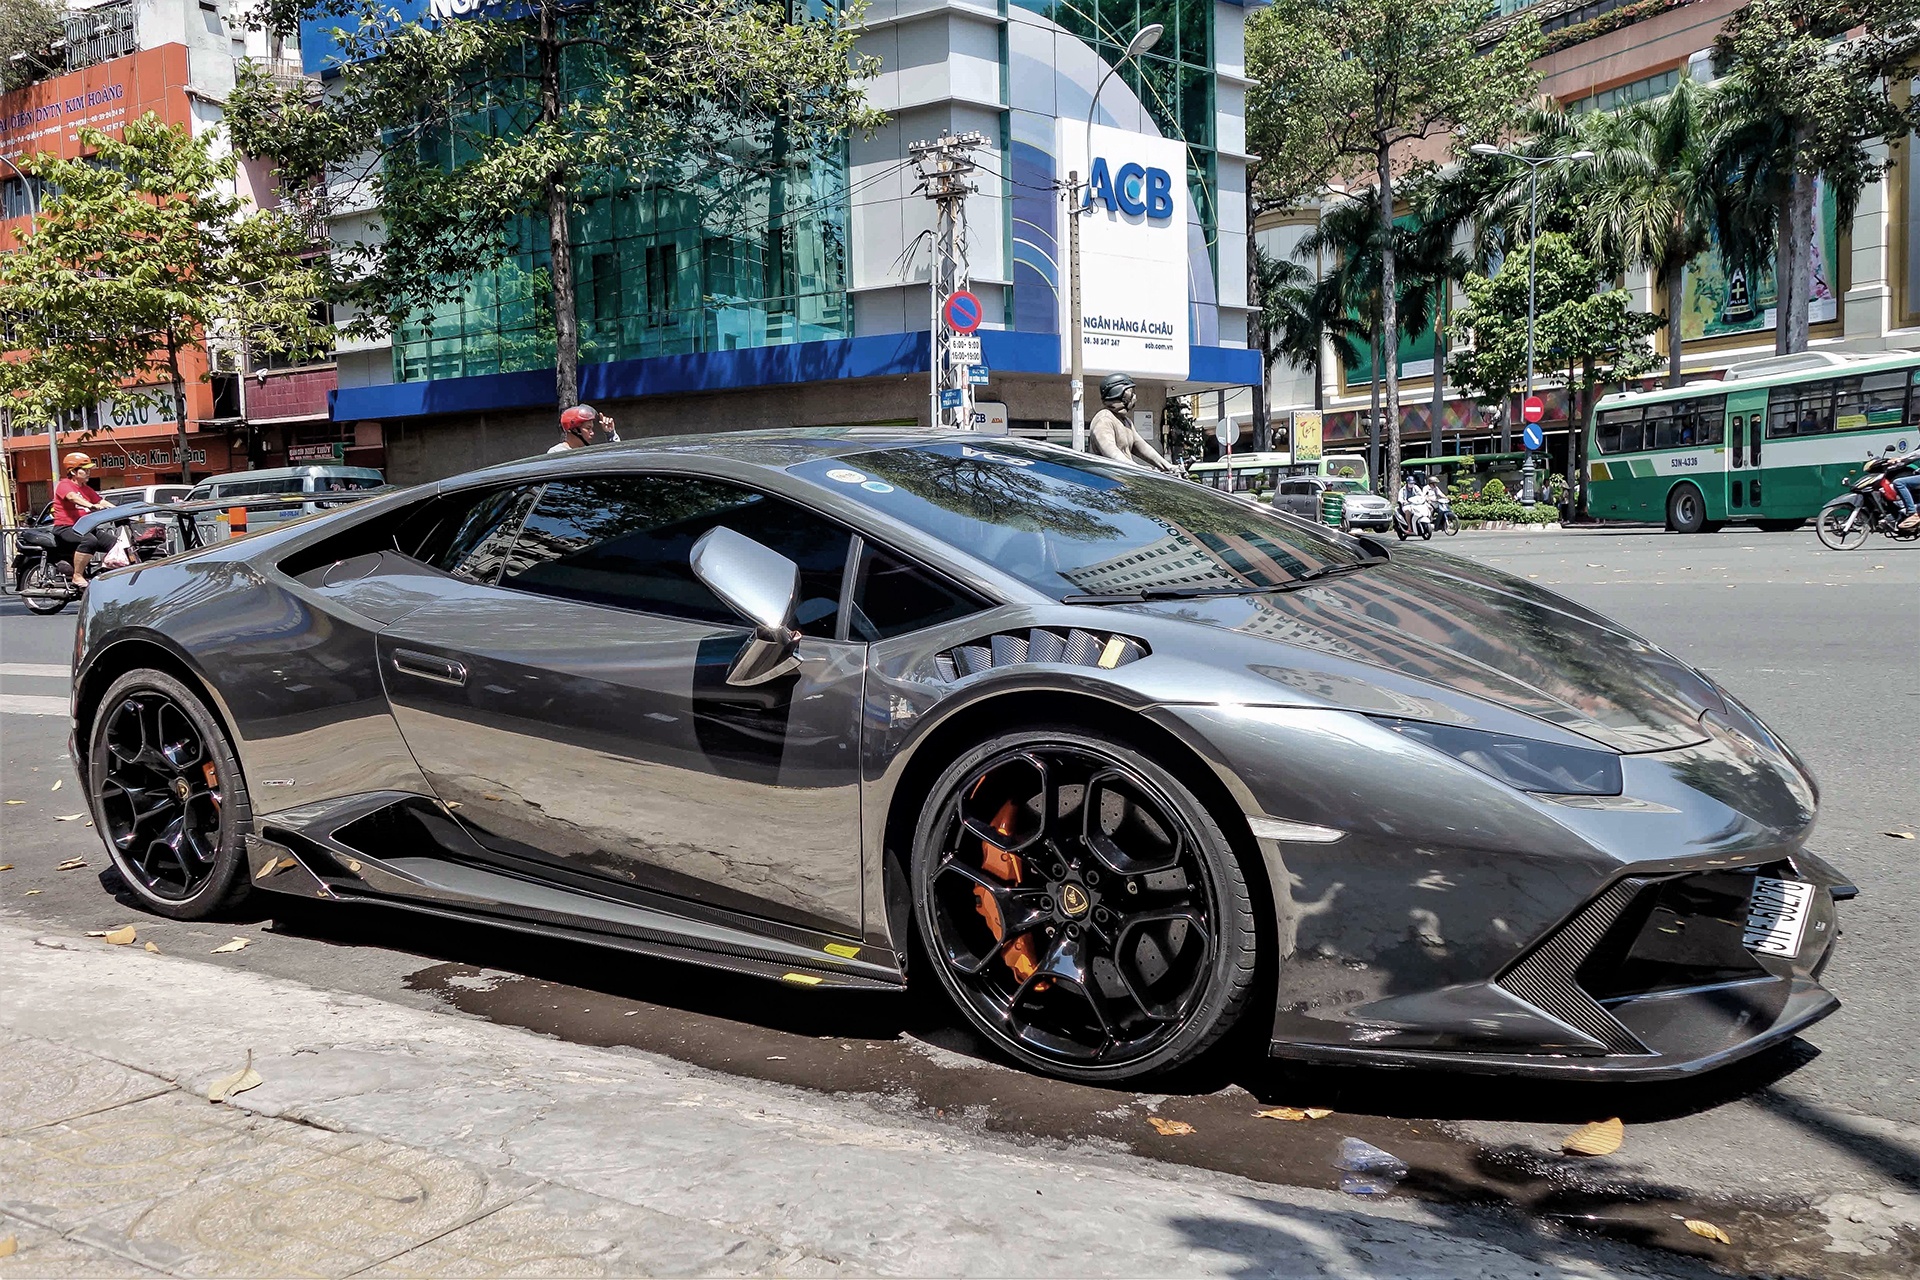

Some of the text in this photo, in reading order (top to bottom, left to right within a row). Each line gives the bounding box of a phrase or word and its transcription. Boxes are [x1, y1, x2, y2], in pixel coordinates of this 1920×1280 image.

[36, 103, 62, 122] DNTN
[65, 95, 86, 113] KIM
[87, 84, 123, 107] HOÀNG
[1082, 157, 1173, 218] ACB
[1083, 315, 1173, 335] NGÂN HÀNG Á CHÂU
[1100, 338, 1110, 346] 247
[1145, 342, 1174, 351] acb.com.vn
[101, 452, 125, 470] Hàng
[150, 448, 170, 465] Kim
[173, 447, 206, 464] Hàng
